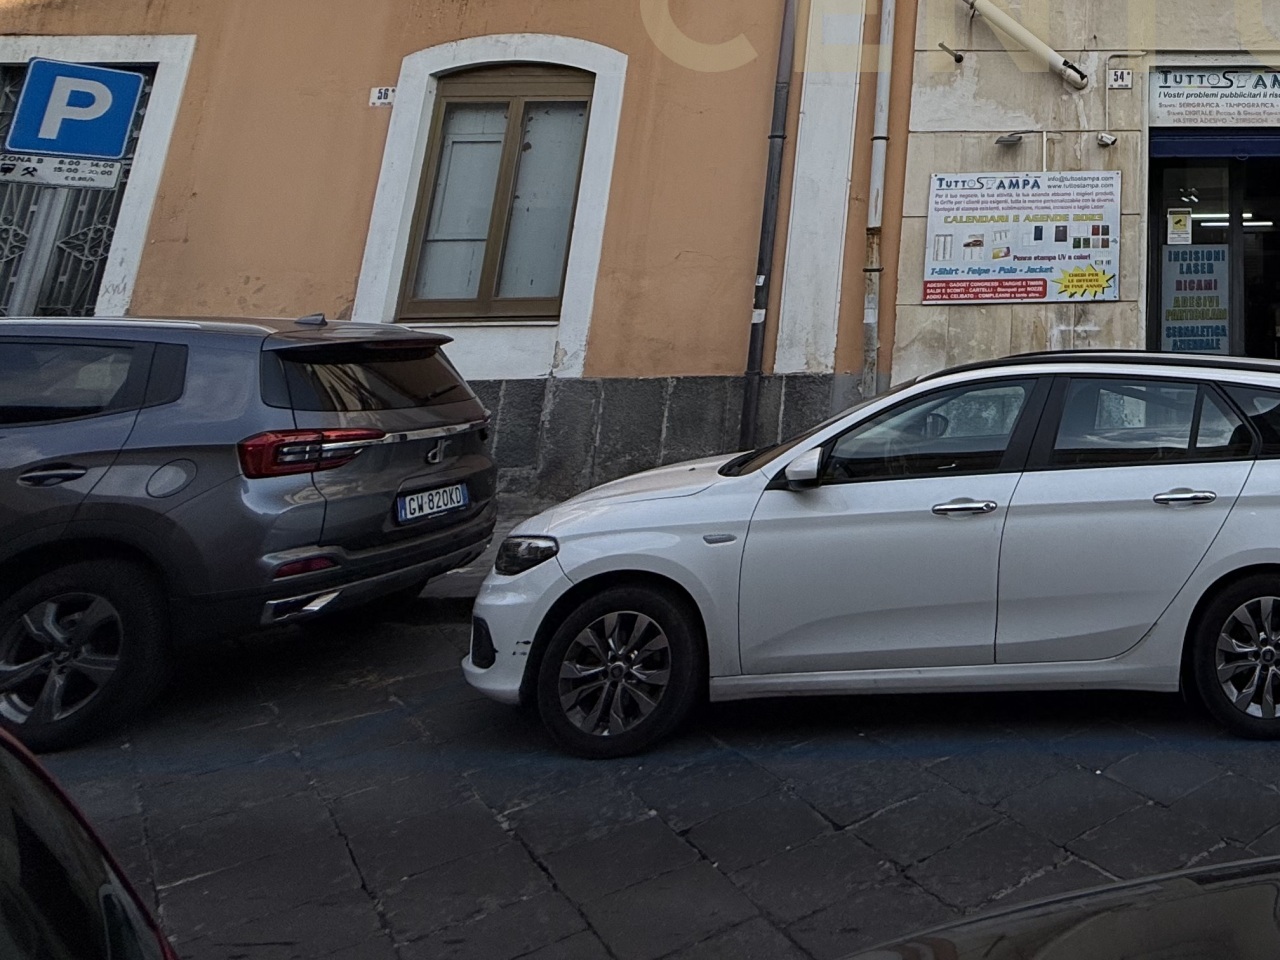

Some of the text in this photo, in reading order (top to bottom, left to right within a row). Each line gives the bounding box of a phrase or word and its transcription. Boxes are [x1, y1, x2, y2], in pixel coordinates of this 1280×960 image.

[1186, 91, 1219, 99] problemi
[1220, 91, 1261, 99] pubblicitari
[38, 76, 112, 139] P
[1, 154, 31, 163] ZONA
[943, 214, 1010, 224] CALENDARI
[1023, 213, 1070, 222] AGENDE
[1168, 249, 1226, 262] INCISIONI
[1179, 262, 1214, 275] LASER
[1175, 279, 1218, 291] RICAMI
[1173, 295, 1220, 308] ADESIVI
[1165, 324, 1227, 339] SEGNALETICA
